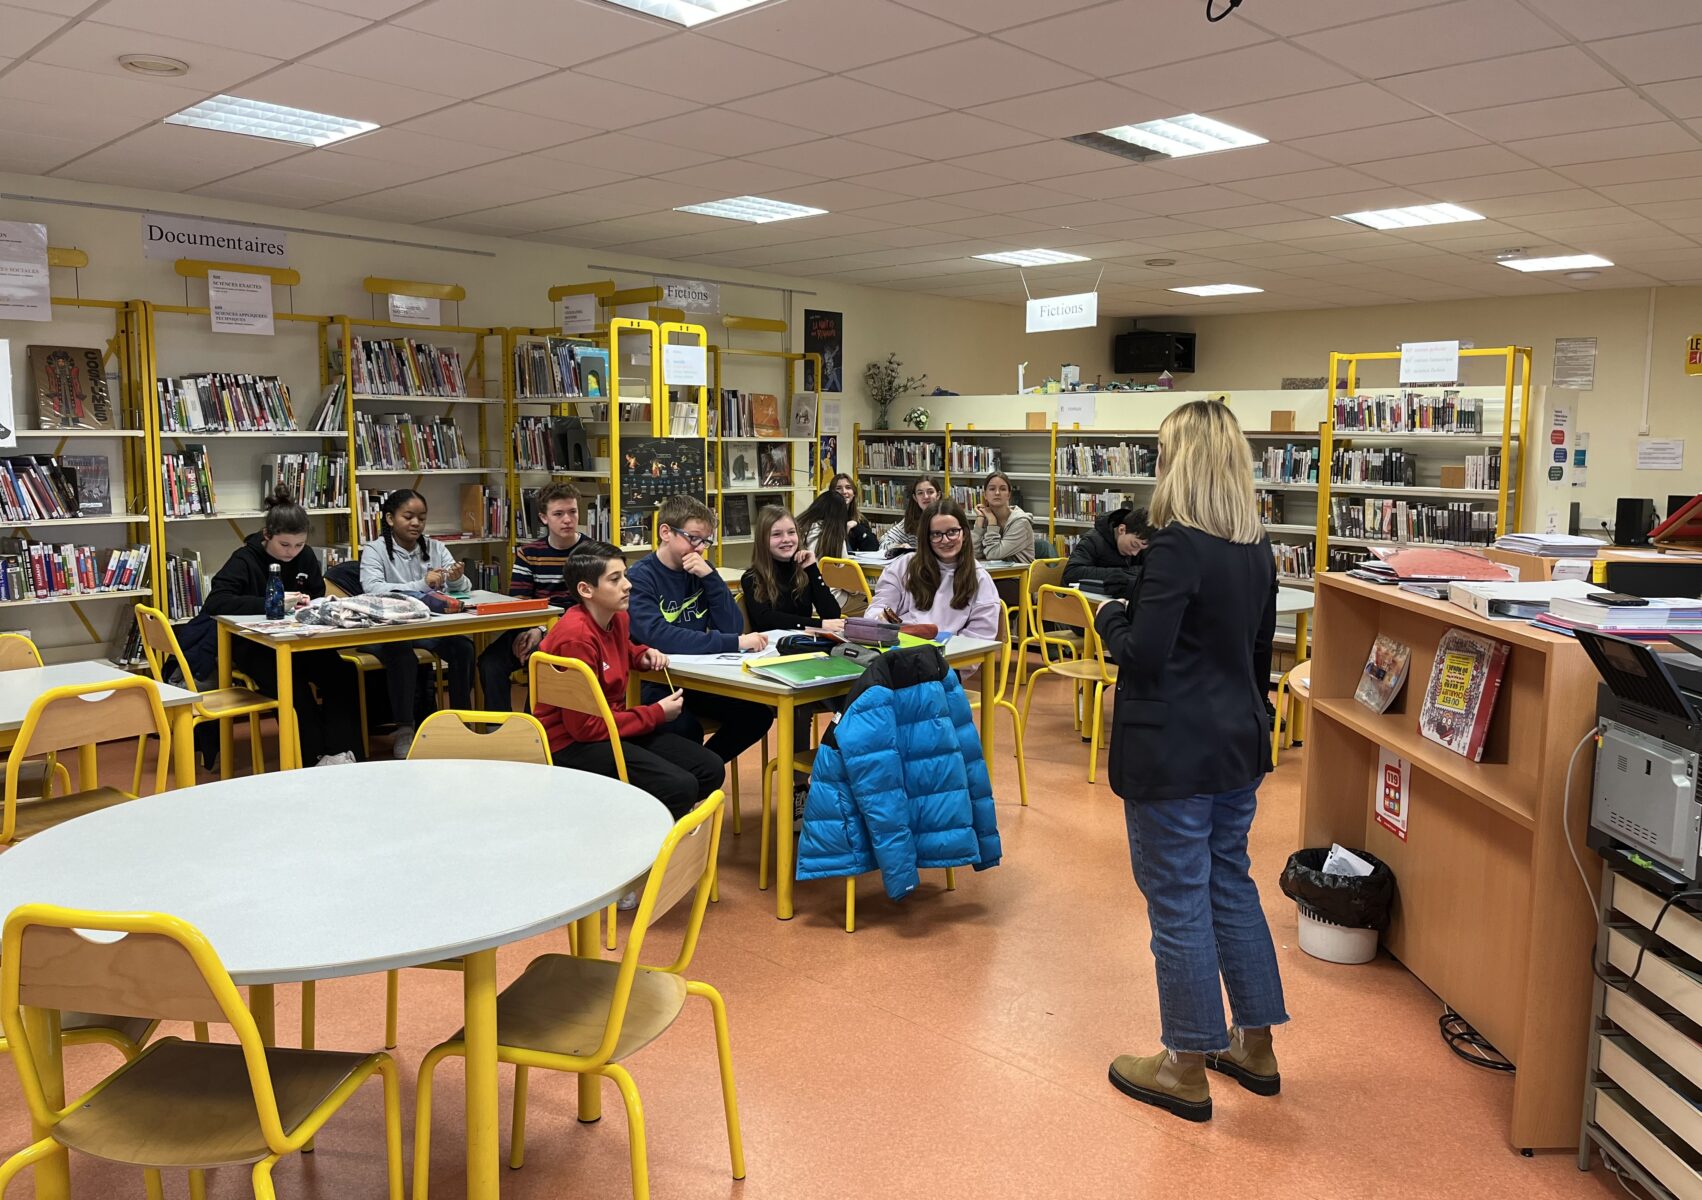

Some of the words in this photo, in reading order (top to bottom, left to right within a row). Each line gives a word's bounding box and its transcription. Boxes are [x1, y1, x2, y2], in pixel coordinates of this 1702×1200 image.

[148, 224, 285, 256] Documentaires
[666, 284, 708, 300] Fictions
[1040, 302, 1084, 318] Fictions
[1388, 772, 1398, 786] 119
